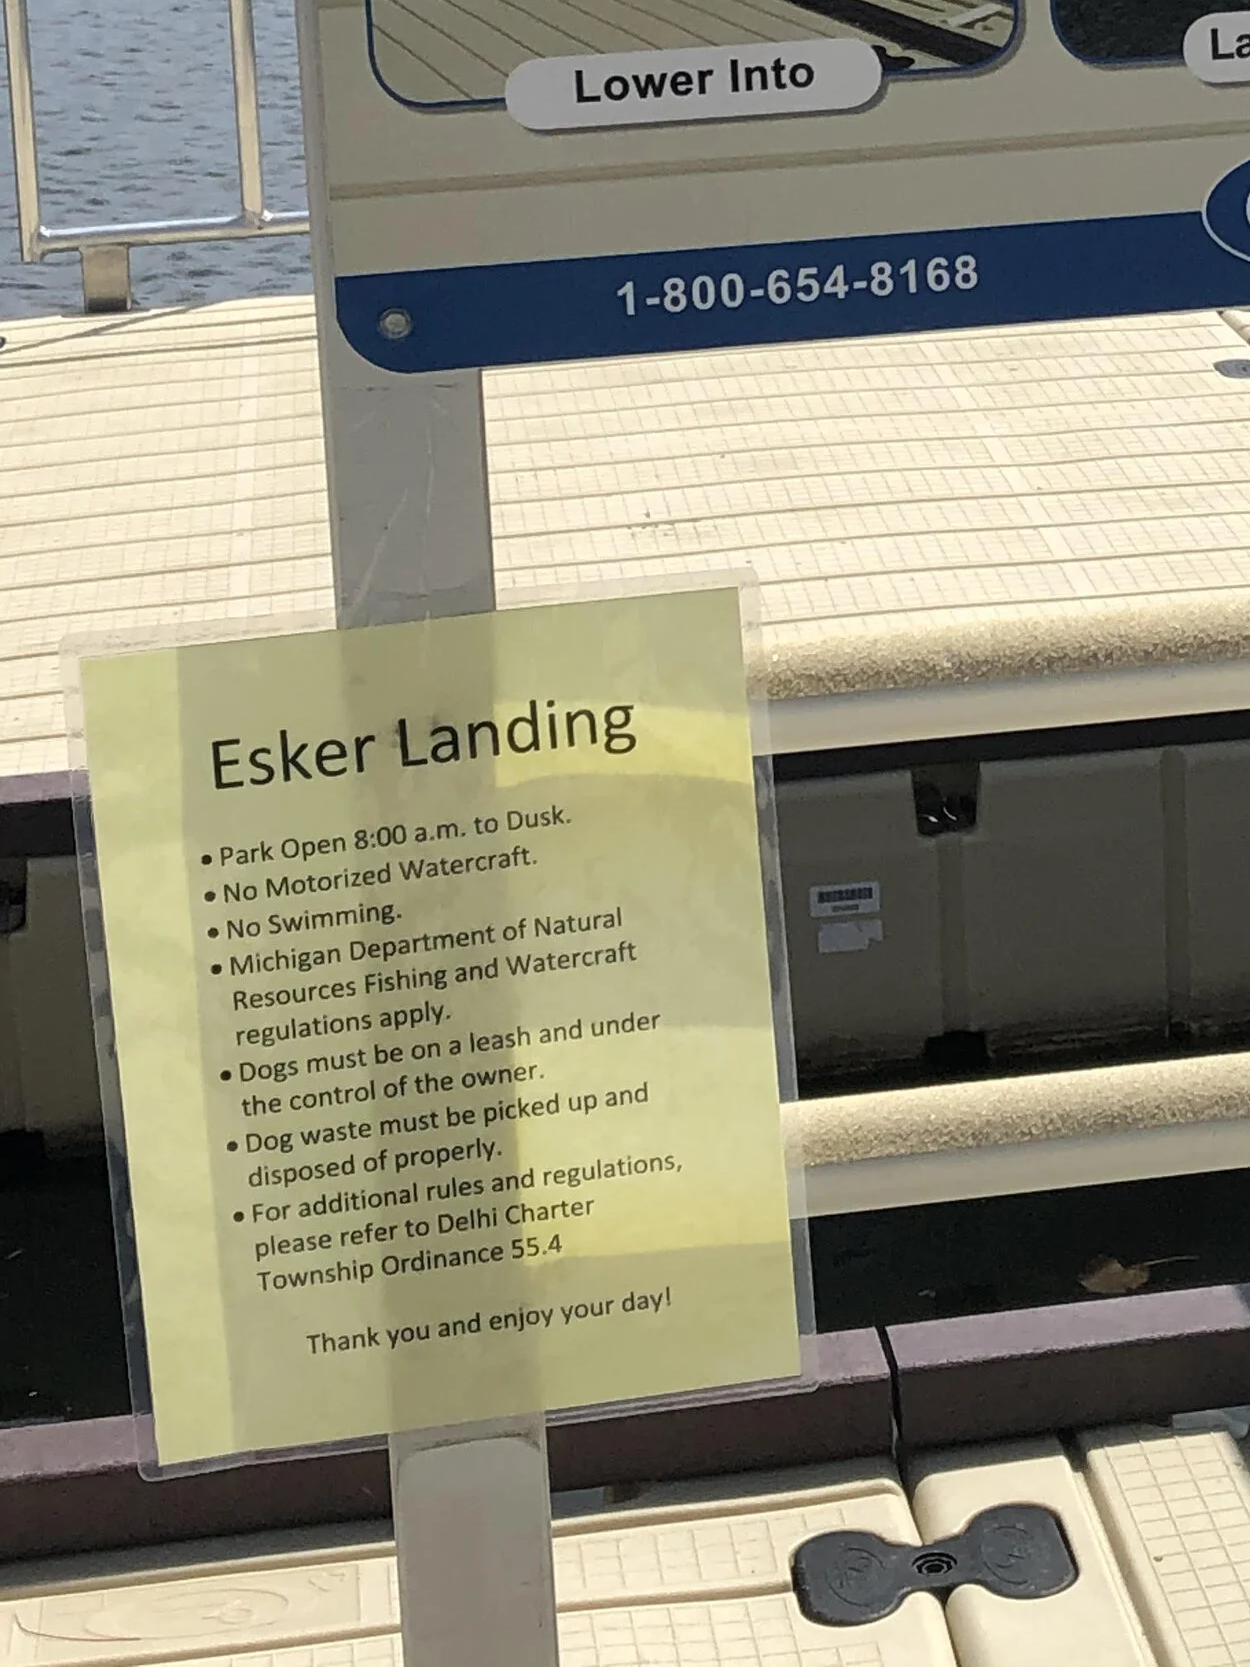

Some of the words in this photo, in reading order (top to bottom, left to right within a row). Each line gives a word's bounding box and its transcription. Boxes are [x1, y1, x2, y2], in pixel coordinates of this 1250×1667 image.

[575, 70, 713, 103] Lower
[731, 58, 814, 92] Into
[618, 255, 977, 315] 1-800-654-8168
[212, 729, 376, 790] Esker
[394, 699, 636, 767] Landing
[220, 841, 274, 866] Park
[281, 837, 346, 861] Open
[354, 825, 407, 850] 8:00
[415, 823, 466, 843] a.m.
[474, 817, 498, 835] to
[507, 805, 571, 830] Dusk.
[224, 882, 257, 903] No
[266, 862, 391, 898] Motorized
[399, 845, 537, 880] Watercraft.
[227, 919, 260, 940] No
[268, 903, 401, 934] Swimming.
[230, 948, 341, 976] Michigan
[350, 926, 496, 962] Department
[503, 918, 526, 941] of
[535, 907, 621, 937] Natural
[233, 981, 356, 1011] Resources
[365, 968, 447, 994] Fishing
[455, 957, 498, 983] and
[506, 941, 637, 976] Watercraft
[236, 1014, 372, 1047] regulations
[379, 1001, 451, 1030] apply.
[239, 1061, 299, 1082] Dogs
[307, 1049, 367, 1073] must
[374, 1044, 403, 1064] be
[411, 1043, 440, 1059] on
[449, 1040, 461, 1055] a
[470, 1026, 530, 1053] leash
[540, 1019, 582, 1043] and
[591, 1012, 660, 1037] under
[241, 1095, 281, 1116] the
[290, 1080, 375, 1110] control
[384, 1075, 407, 1098] of
[414, 1073, 453, 1094] the
[462, 1065, 544, 1088] owner.
[246, 1133, 293, 1153] Dog
[300, 1122, 371, 1145] waste
[380, 1112, 439, 1135] must
[446, 1106, 476, 1127] be
[484, 1093, 559, 1127] picked
[569, 1094, 597, 1115] up
[605, 1082, 648, 1107] and
[249, 1154, 355, 1188] disposed
[363, 1149, 387, 1172] of
[395, 1138, 502, 1173] properly.
[252, 1203, 291, 1223] For
[298, 1182, 418, 1217] additional
[427, 1177, 484, 1201] rules
[492, 1168, 535, 1192] and
[543, 1155, 682, 1187] regulations,
[255, 1234, 332, 1262] please
[341, 1223, 398, 1246] refer
[405, 1220, 429, 1237] to
[438, 1208, 497, 1234] Delhi
[505, 1200, 594, 1224] Charter
[256, 1260, 373, 1291] Township
[381, 1246, 503, 1275] Ordinance
[512, 1234, 562, 1259] 55.4
[306, 1326, 380, 1354] Thank
[386, 1325, 430, 1349] you
[438, 1312, 481, 1337] and
[489, 1307, 553, 1332] enjoy
[561, 1300, 614, 1325] your
[622, 1286, 671, 1313] day!
